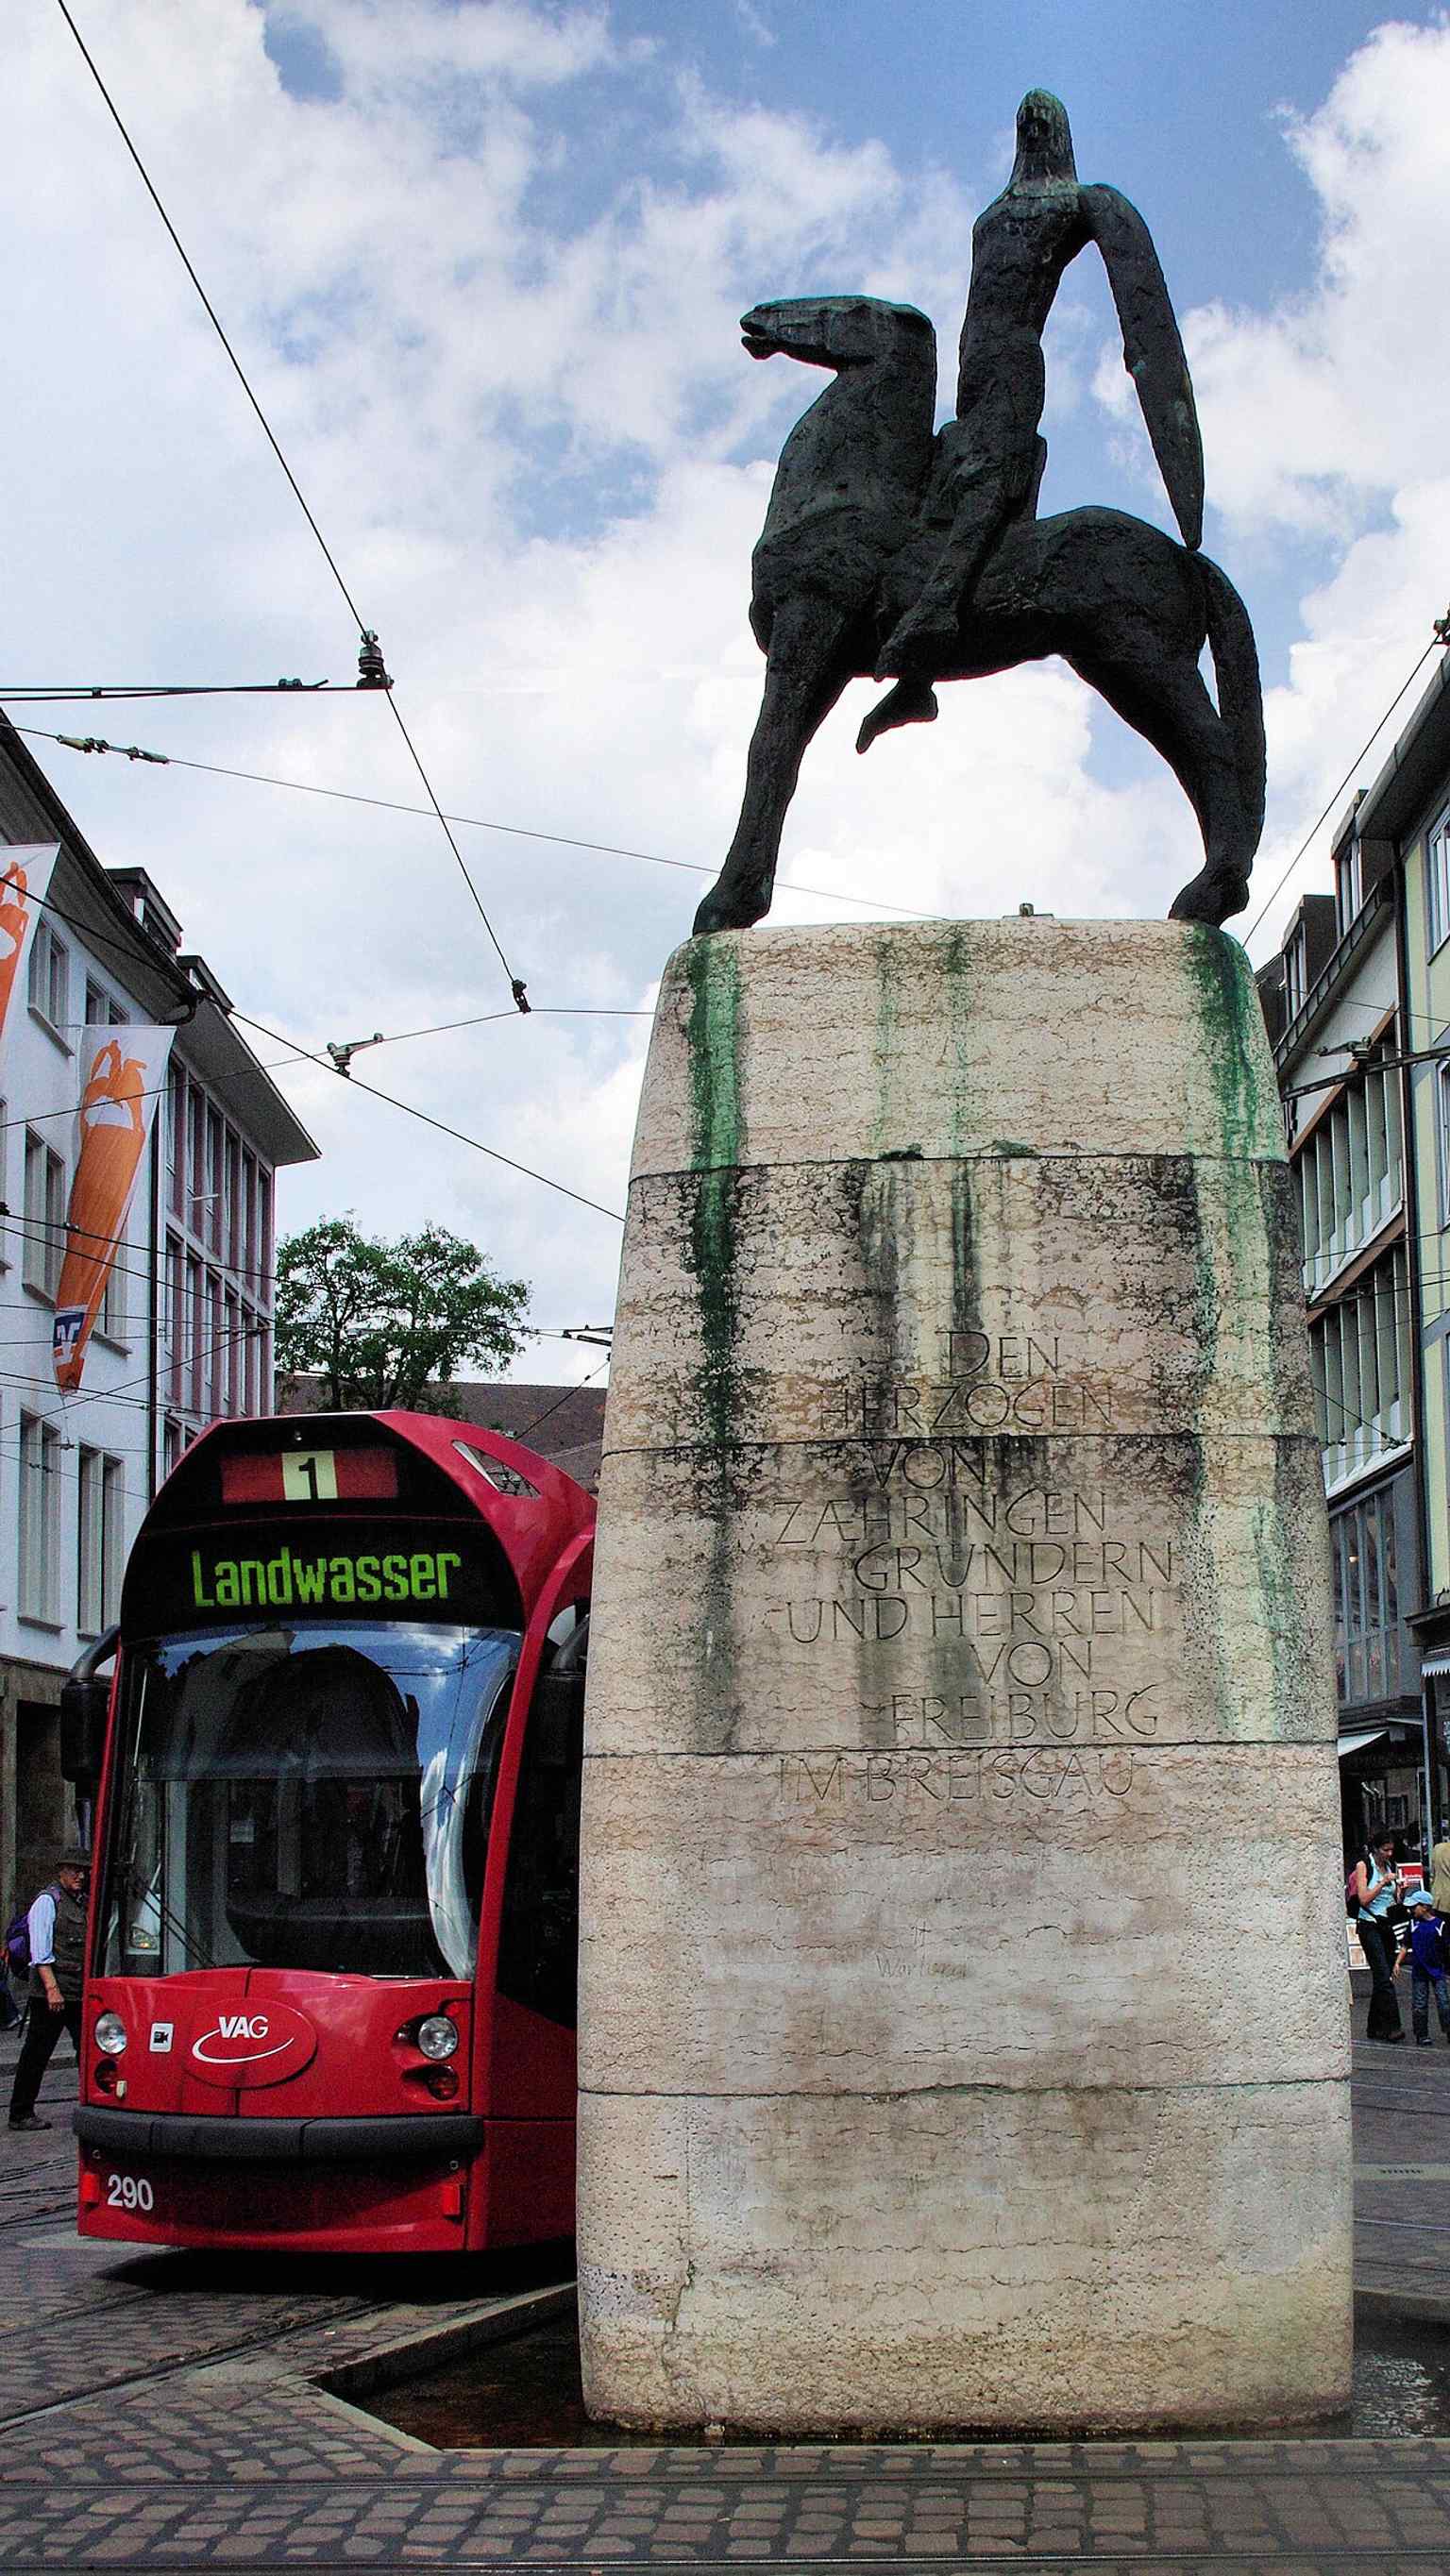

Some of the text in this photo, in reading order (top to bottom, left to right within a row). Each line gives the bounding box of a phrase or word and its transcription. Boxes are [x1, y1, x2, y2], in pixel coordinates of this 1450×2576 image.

[935, 1330, 1060, 1379] DEN
[819, 1379, 1113, 1431] HERZOGEN
[297, 1456, 317, 1500] 1
[866, 1444, 989, 1490] VON
[192, 1545, 462, 1608] Landwasser
[784, 1590, 1155, 1644] UND HERREN
[969, 1640, 1093, 1688] VON
[890, 1684, 1158, 1741] FREIBURG
[777, 1751, 1136, 1804] IM BREISGAU
[218, 2014, 269, 2040] VAG
[106, 2174, 155, 2212] 290
